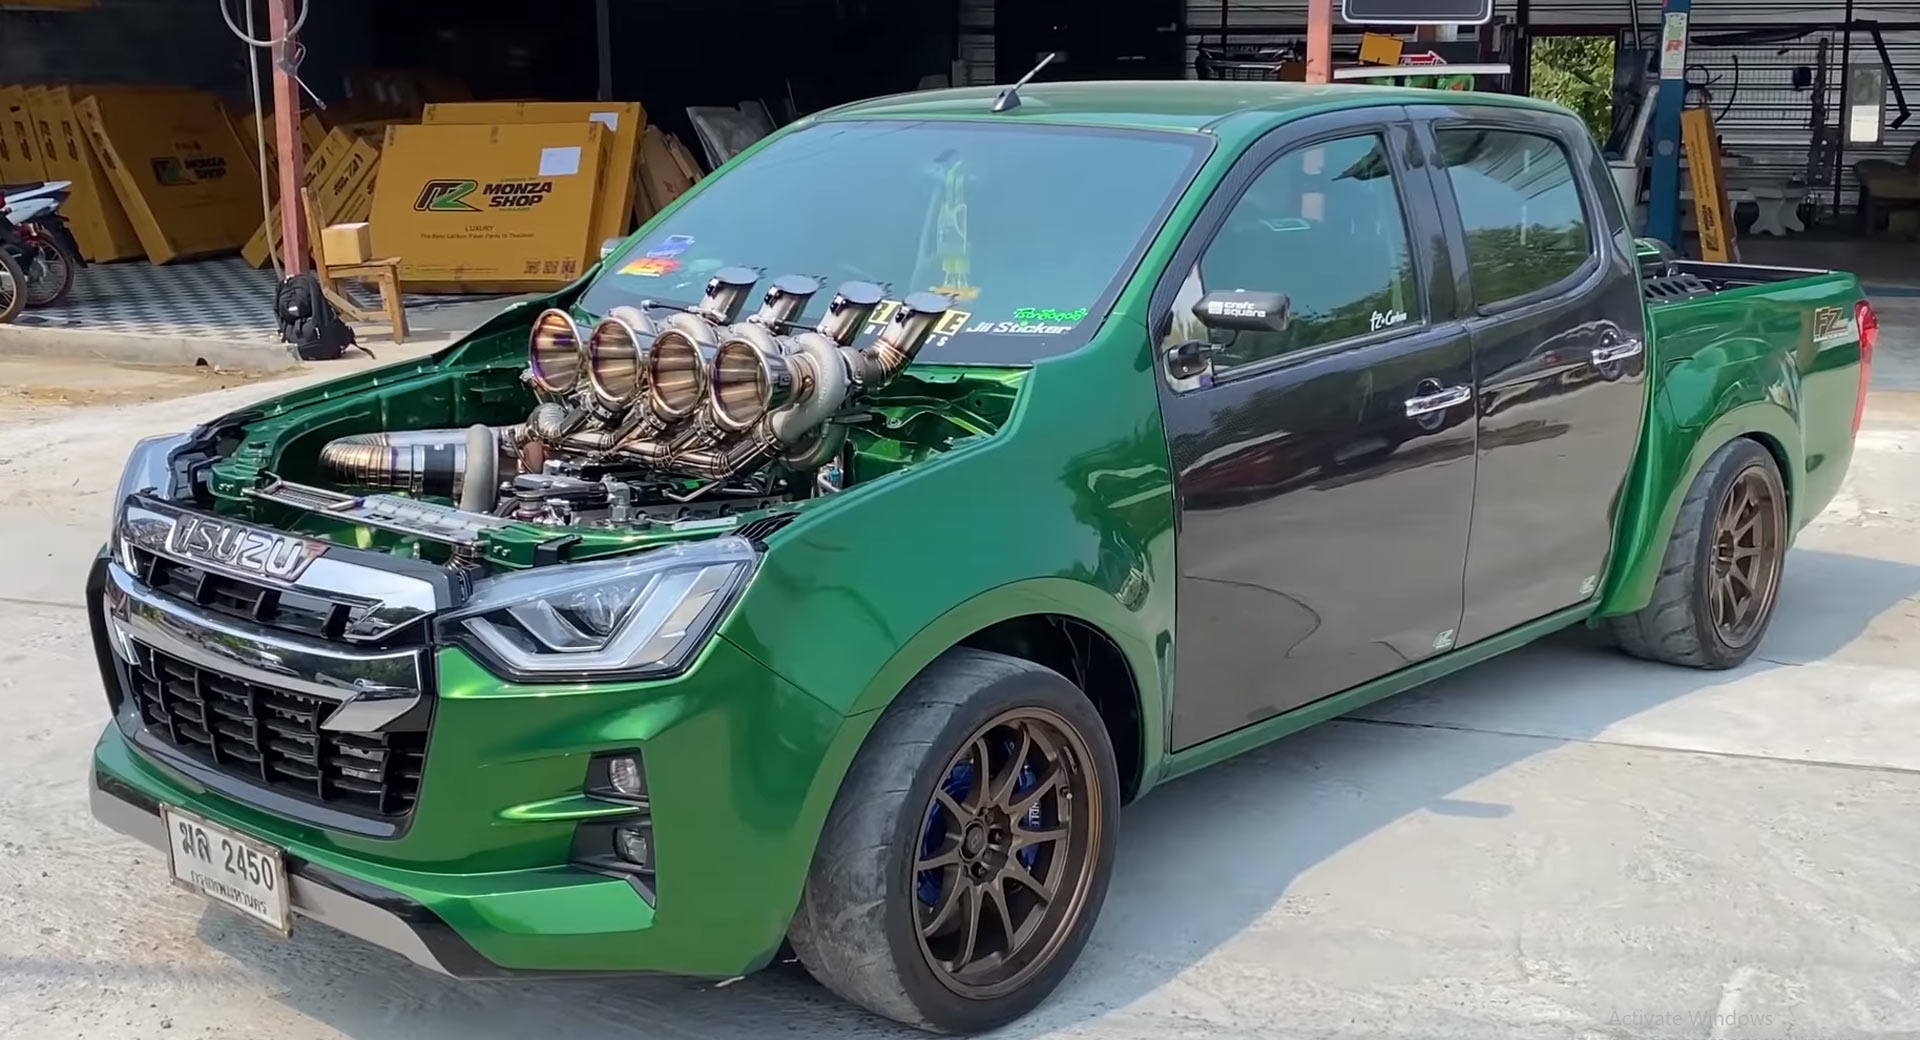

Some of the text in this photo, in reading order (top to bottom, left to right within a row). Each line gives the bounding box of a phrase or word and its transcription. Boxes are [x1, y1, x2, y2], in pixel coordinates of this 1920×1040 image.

[482, 182, 553, 195] MONZA
[489, 195, 544, 207] SHOP
[1223, 308, 1267, 318] square
[993, 321, 1072, 334] Sticker
[178, 514, 305, 577] ISUZU
[222, 839, 274, 891] 2450
[190, 870, 268, 915] กรุงเทพมหานคร
